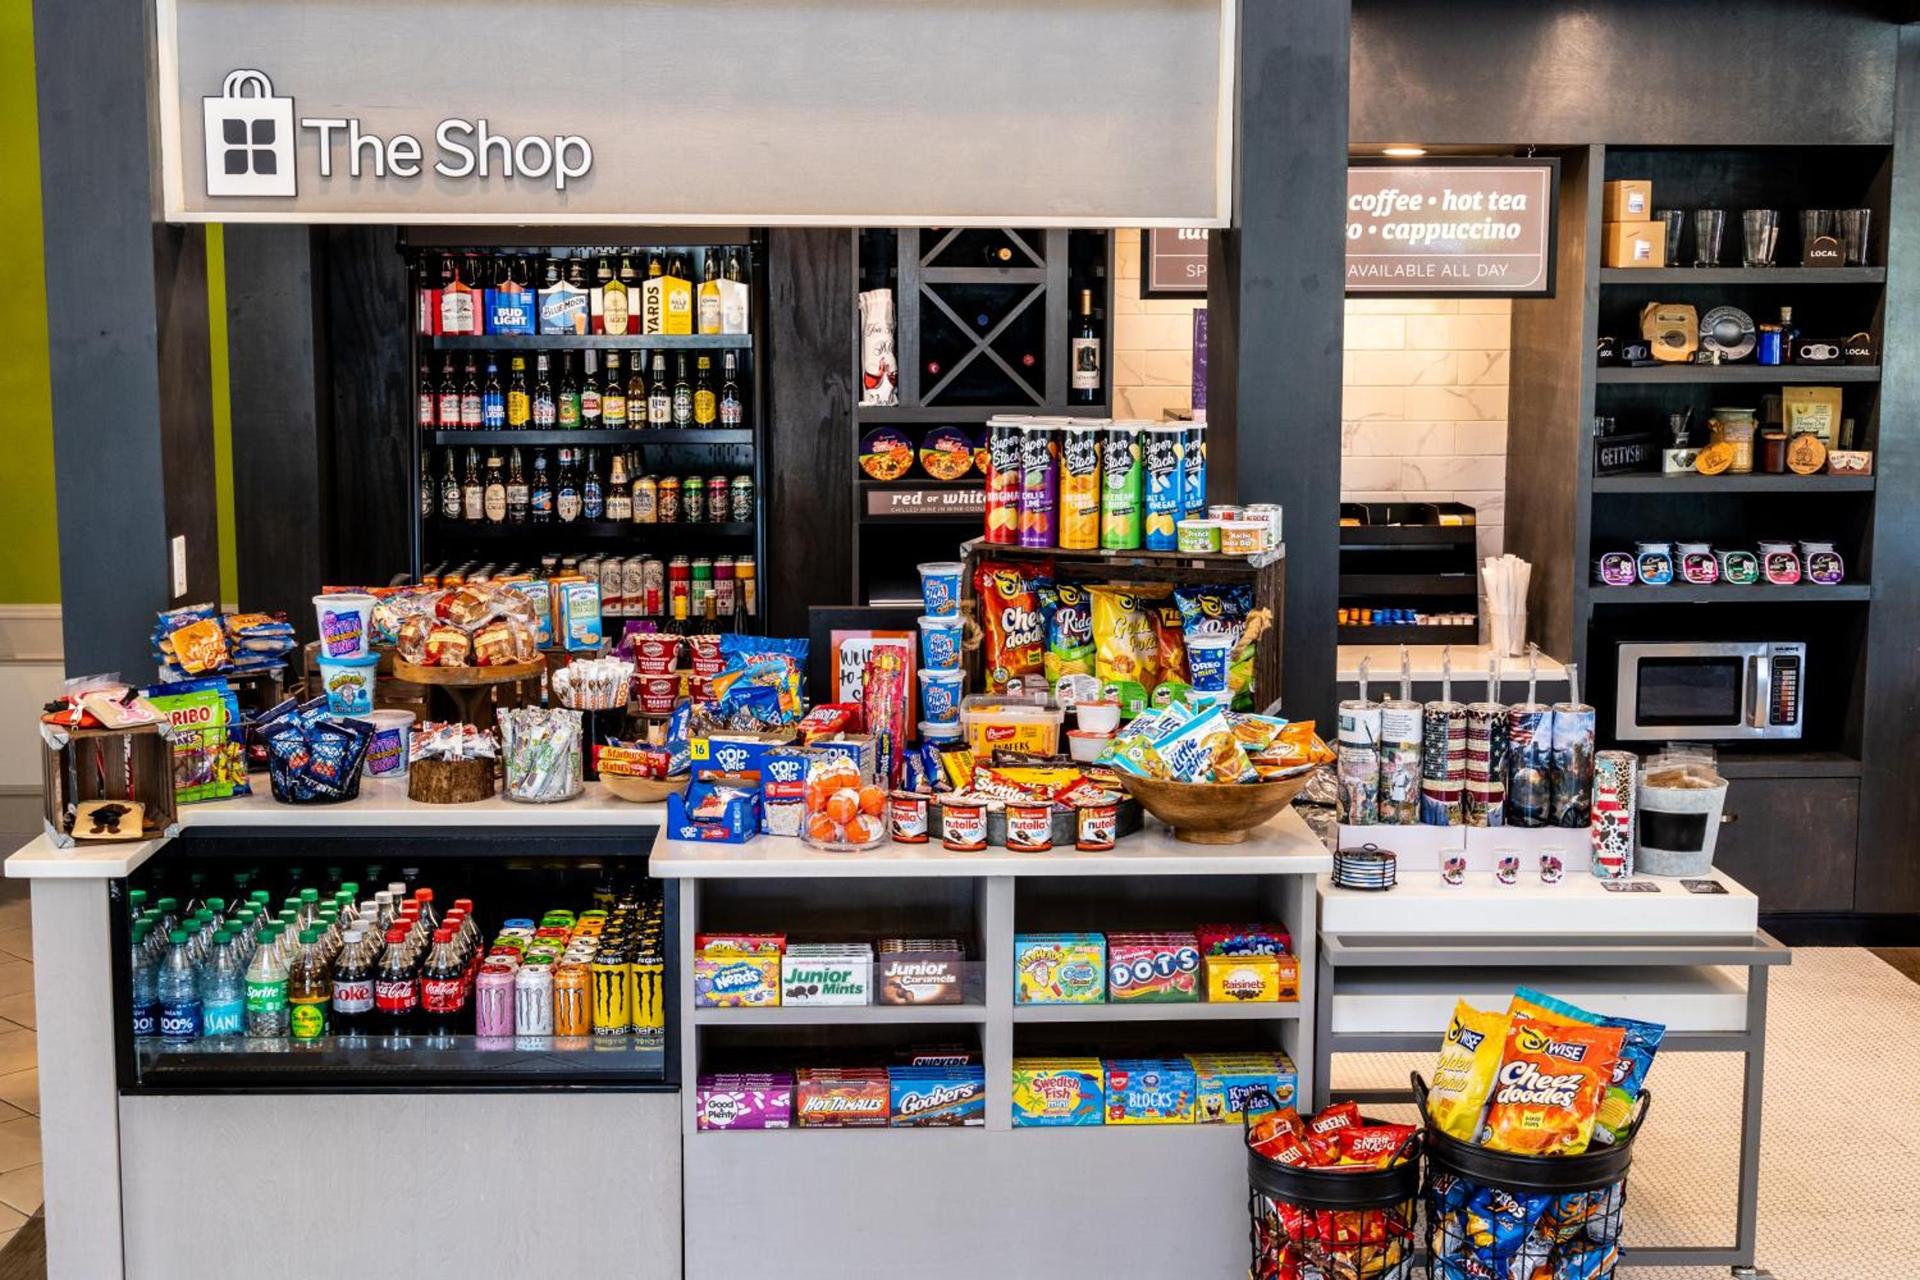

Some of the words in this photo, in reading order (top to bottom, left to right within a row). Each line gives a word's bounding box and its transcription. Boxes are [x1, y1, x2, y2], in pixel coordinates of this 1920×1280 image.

[302, 118, 422, 177] The
[434, 118, 593, 190] Shop
[1348, 189, 1423, 217] coffee
[1442, 189, 1481, 211] hot
[1488, 192, 1527, 211] tea
[1382, 218, 1521, 245] cappuccino
[1348, 264, 1435, 278] AVAILABLE
[1442, 264, 1471, 277] ALL
[1477, 264, 1509, 277] DAY
[498, 307, 523, 317] BUD
[648, 286, 660, 335] YARDS
[493, 316, 527, 325] LIGHT
[990, 435, 1019, 451] Super
[1020, 437, 1047, 453] Super
[1064, 438, 1094, 454] Super
[1102, 438, 1128, 454] Super
[1146, 438, 1172, 455] Super
[1022, 450, 1050, 468] Stack
[1067, 452, 1096, 470] Stack
[1104, 451, 1132, 470] Stack
[1147, 451, 1176, 470] Stack
[892, 491, 922, 505] red
[927, 494, 939, 503] or
[1056, 608, 1092, 642] Ridg
[1191, 661, 1221, 672] OREO
[840, 669, 855, 683] to
[172, 706, 211, 726] RIBO
[694, 744, 704, 755] 16
[1172, 738, 1198, 772] Little
[891, 811, 916, 822] utella
[945, 820, 979, 830] nutella
[1011, 820, 1045, 830] nutella
[784, 967, 852, 984] Junior
[884, 961, 947, 976] Junior
[1113, 950, 1196, 985] DOTS
[902, 974, 956, 985] Caramels
[1222, 979, 1266, 989] Raisinets
[247, 986, 279, 998] Sprite
[821, 983, 864, 995] Mints
[204, 1014, 239, 1035] ASANI
[632, 1026, 665, 1035] Reha
[1549, 1043, 1584, 1060] WISE
[1500, 1061, 1585, 1090] Cheez
[1032, 1076, 1079, 1092] Swedish
[901, 1083, 975, 1114] Goobers
[1044, 1088, 1071, 1099] Fish
[1129, 1092, 1172, 1107] BLOCKS
[1498, 1084, 1576, 1107] doodles
[708, 1100, 734, 1108] Good
[803, 1096, 832, 1112] HOT
[830, 1096, 883, 1111] TAMALES
[1048, 1100, 1068, 1108] mini
[708, 1110, 737, 1119] Plenty
[1313, 1113, 1350, 1134] CHEEZ-IT
